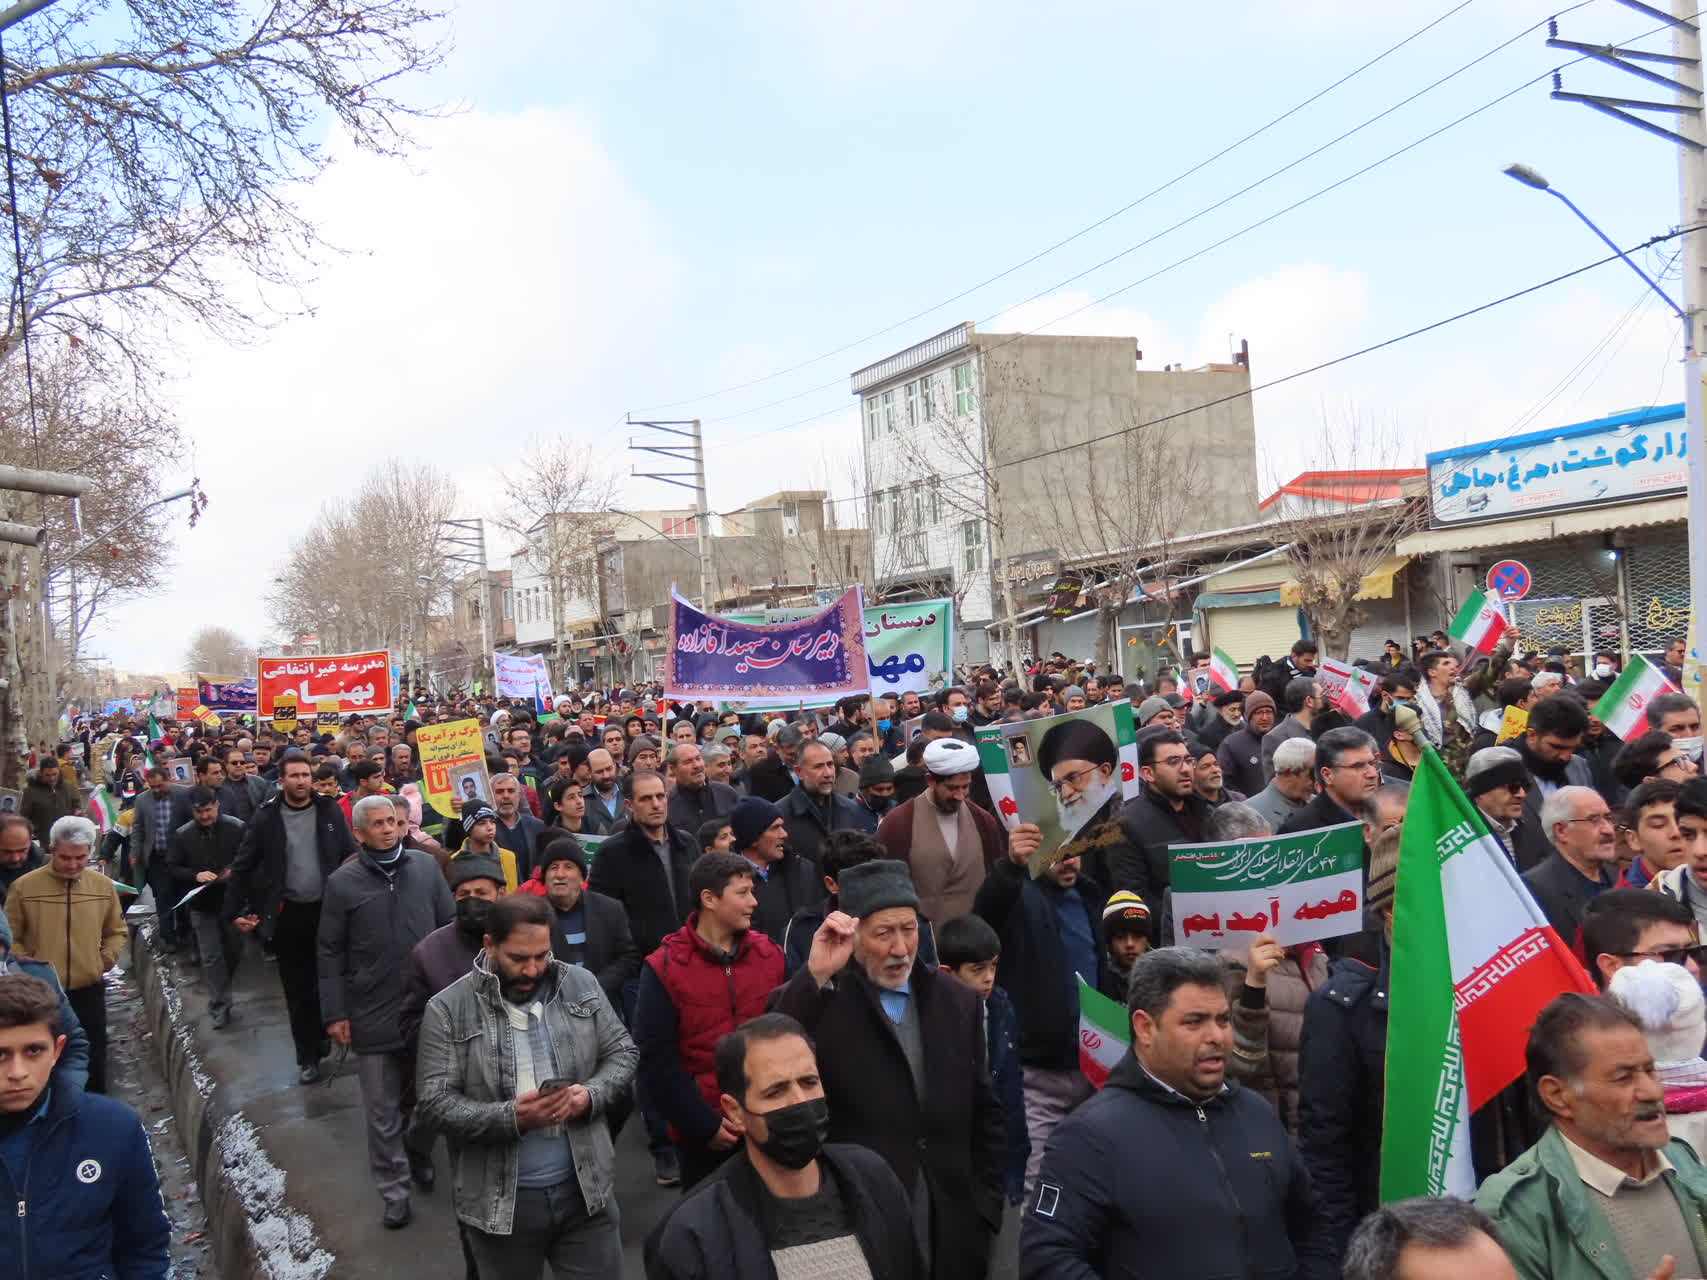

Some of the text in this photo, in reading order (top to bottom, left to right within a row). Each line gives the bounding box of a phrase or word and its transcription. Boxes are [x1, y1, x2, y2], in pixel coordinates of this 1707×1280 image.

[1441, 467, 1496, 497] ماهی
[866, 613, 937, 637] دبستان
[1536, 603, 1582, 632] گوشت
[678, 623, 840, 673] دبیرستان شهید آقازاده
[263, 660, 385, 679] مدرسه غیر انتفاعی
[418, 726, 479, 744] مرگ بر آمریکا
[1216, 844, 1281, 880] اسلامی
[1248, 849, 1304, 880] انقلاب
[1183, 889, 1357, 937] همه آمدیم
